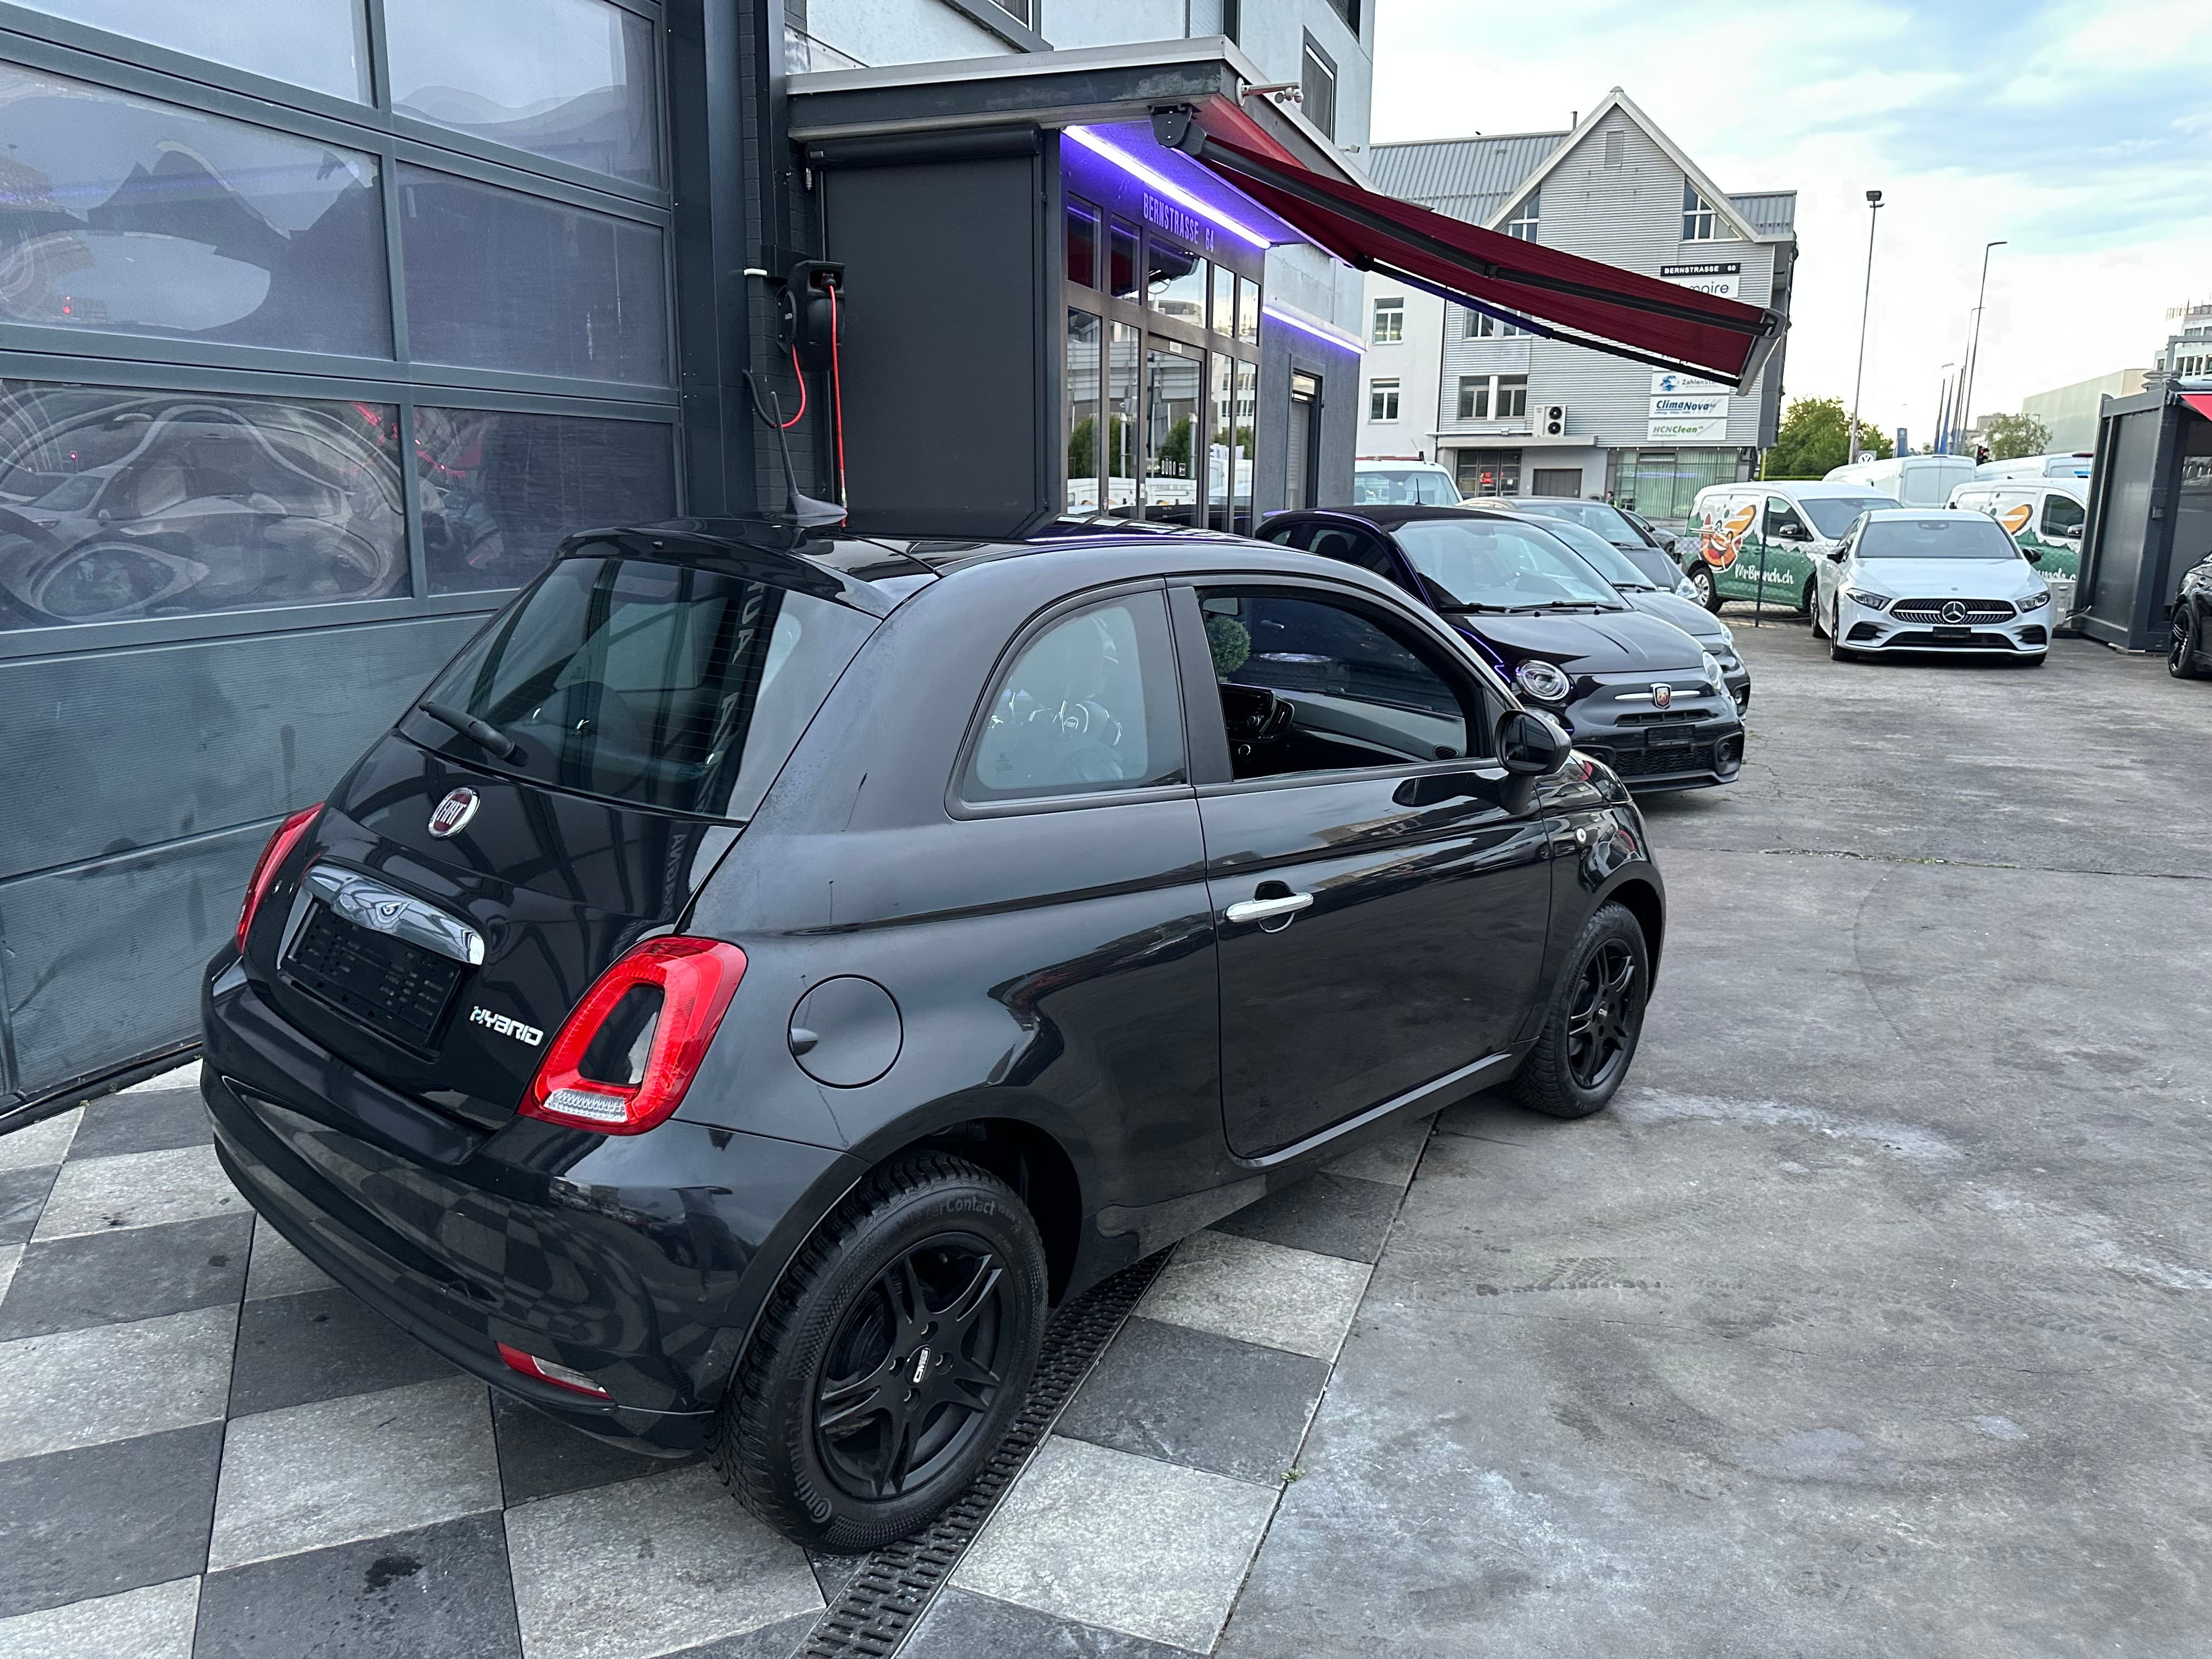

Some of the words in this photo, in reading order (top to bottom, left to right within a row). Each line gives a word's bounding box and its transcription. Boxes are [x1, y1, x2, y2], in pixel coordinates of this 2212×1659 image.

[1143, 192, 1199, 245] BERNSTRASSE
[1205, 228, 1214, 252] 64
[1664, 266, 1719, 274] BERNSTRASSE
[1656, 400, 1709, 410] ClimaNova
[437, 799, 467, 825] FIAT
[470, 1006, 544, 1046] HYBRID
[913, 1349, 928, 1383] CMS
